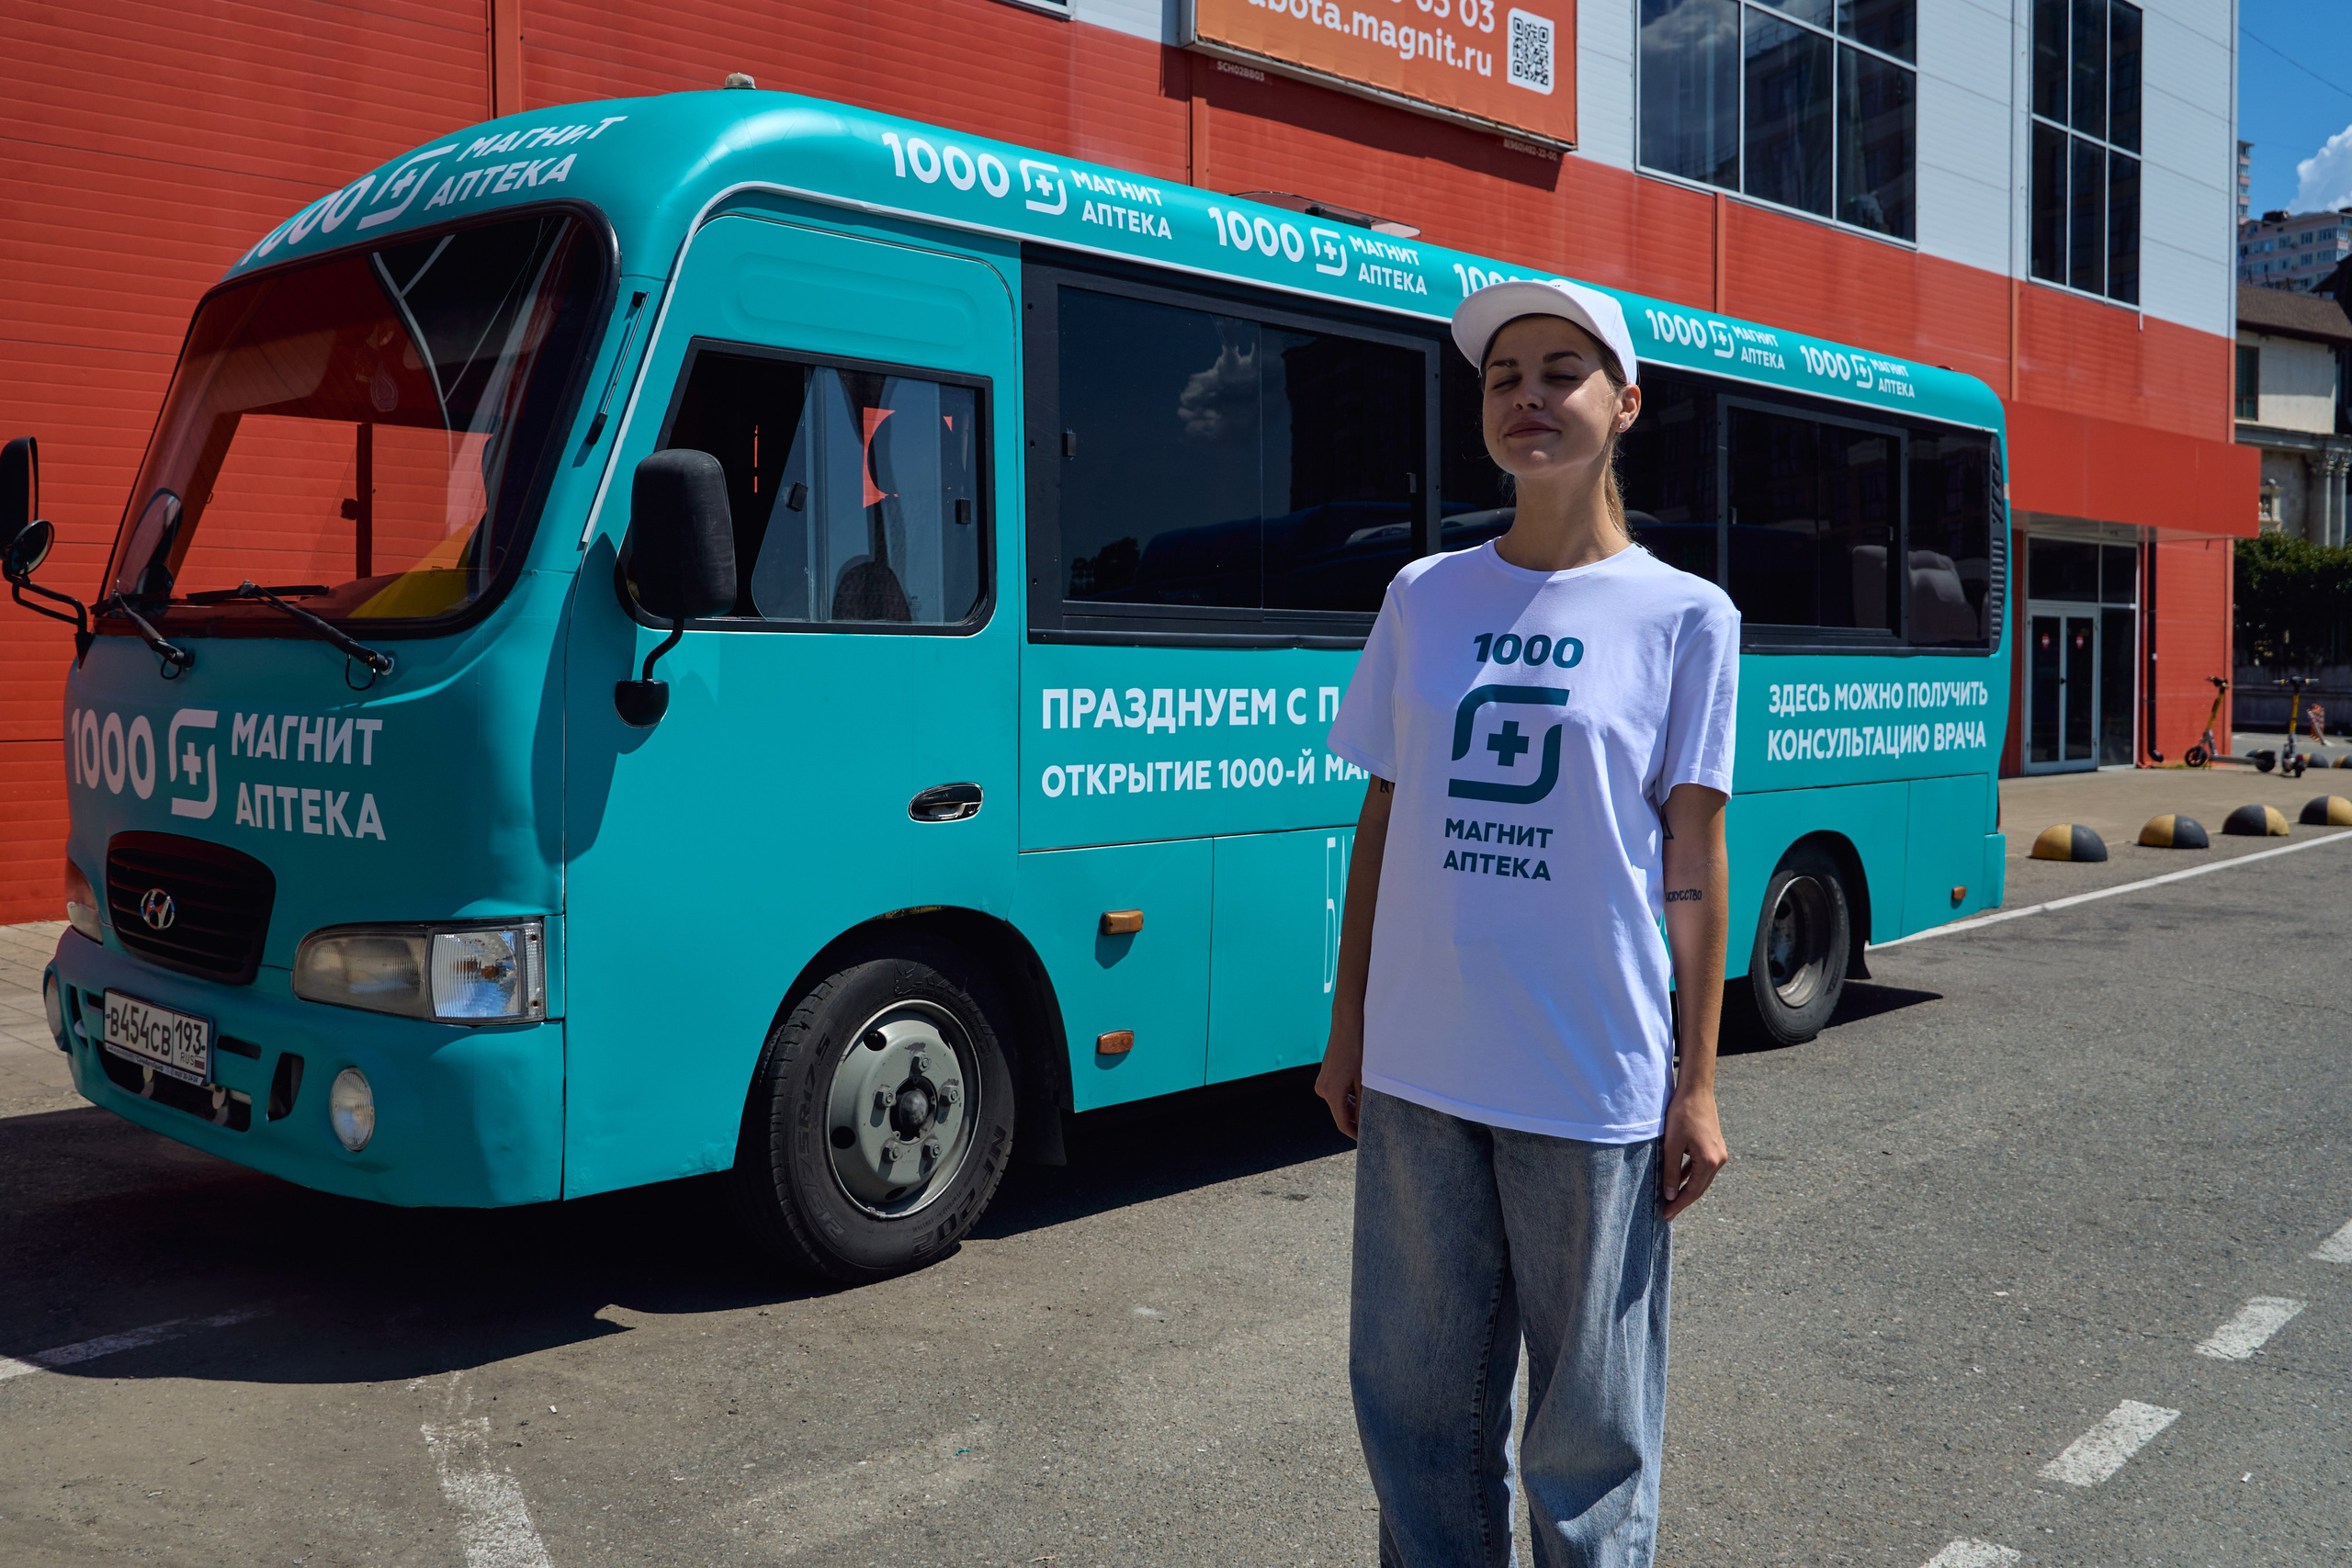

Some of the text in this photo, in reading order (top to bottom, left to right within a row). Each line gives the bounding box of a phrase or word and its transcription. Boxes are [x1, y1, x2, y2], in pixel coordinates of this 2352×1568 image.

[1459, 0, 1495, 33] 03
[1248, 0, 1493, 77] ota.magnit.ru
[456, 116, 628, 162] МАГНИТ
[424, 154, 577, 210] АПТЕКА
[881, 132, 1010, 197] 1000
[1069, 169, 1162, 206] МАГНИТ
[241, 175, 377, 265] 1000
[1081, 200, 1172, 240] АПТЕКА
[1207, 207, 1305, 263] 1000
[1348, 235, 1419, 265] МАГНИТ
[1358, 263, 1428, 295] АПТЕКА
[1453, 263, 1519, 298] 10
[1645, 309, 1707, 349] 1000
[1731, 325, 1779, 347] МАГНИТ
[1740, 346, 1785, 369] АПТЕКА
[1799, 344, 1850, 381] 1000
[1870, 358, 1909, 378] МАГНИТ
[1878, 378, 1915, 398] АПТЕКА
[1473, 632, 1584, 669] 1000
[1042, 687, 1276, 735] ПРАЗДНУЕМ
[1286, 687, 1306, 725] С
[1769, 681, 1988, 717] ЗДЕСЬ МОЖНО ПОЛУЧИТЬ
[72, 708, 155, 800] 1000
[232, 712, 383, 766] МАГНИТ
[1767, 720, 1986, 761] КОНСУЛЬТАЦИЮ ВРАЧА
[1042, 760, 1212, 798] ОТКРЫТИЕ
[1218, 748, 1315, 789] 1000-Й
[235, 782, 387, 840] АПТЕКА
[1444, 818, 1554, 849] МАГНИТ
[1442, 850, 1552, 882] АПТЕКА
[175, 1019, 202, 1055] 193
[180, 1051, 195, 1066] RUS
